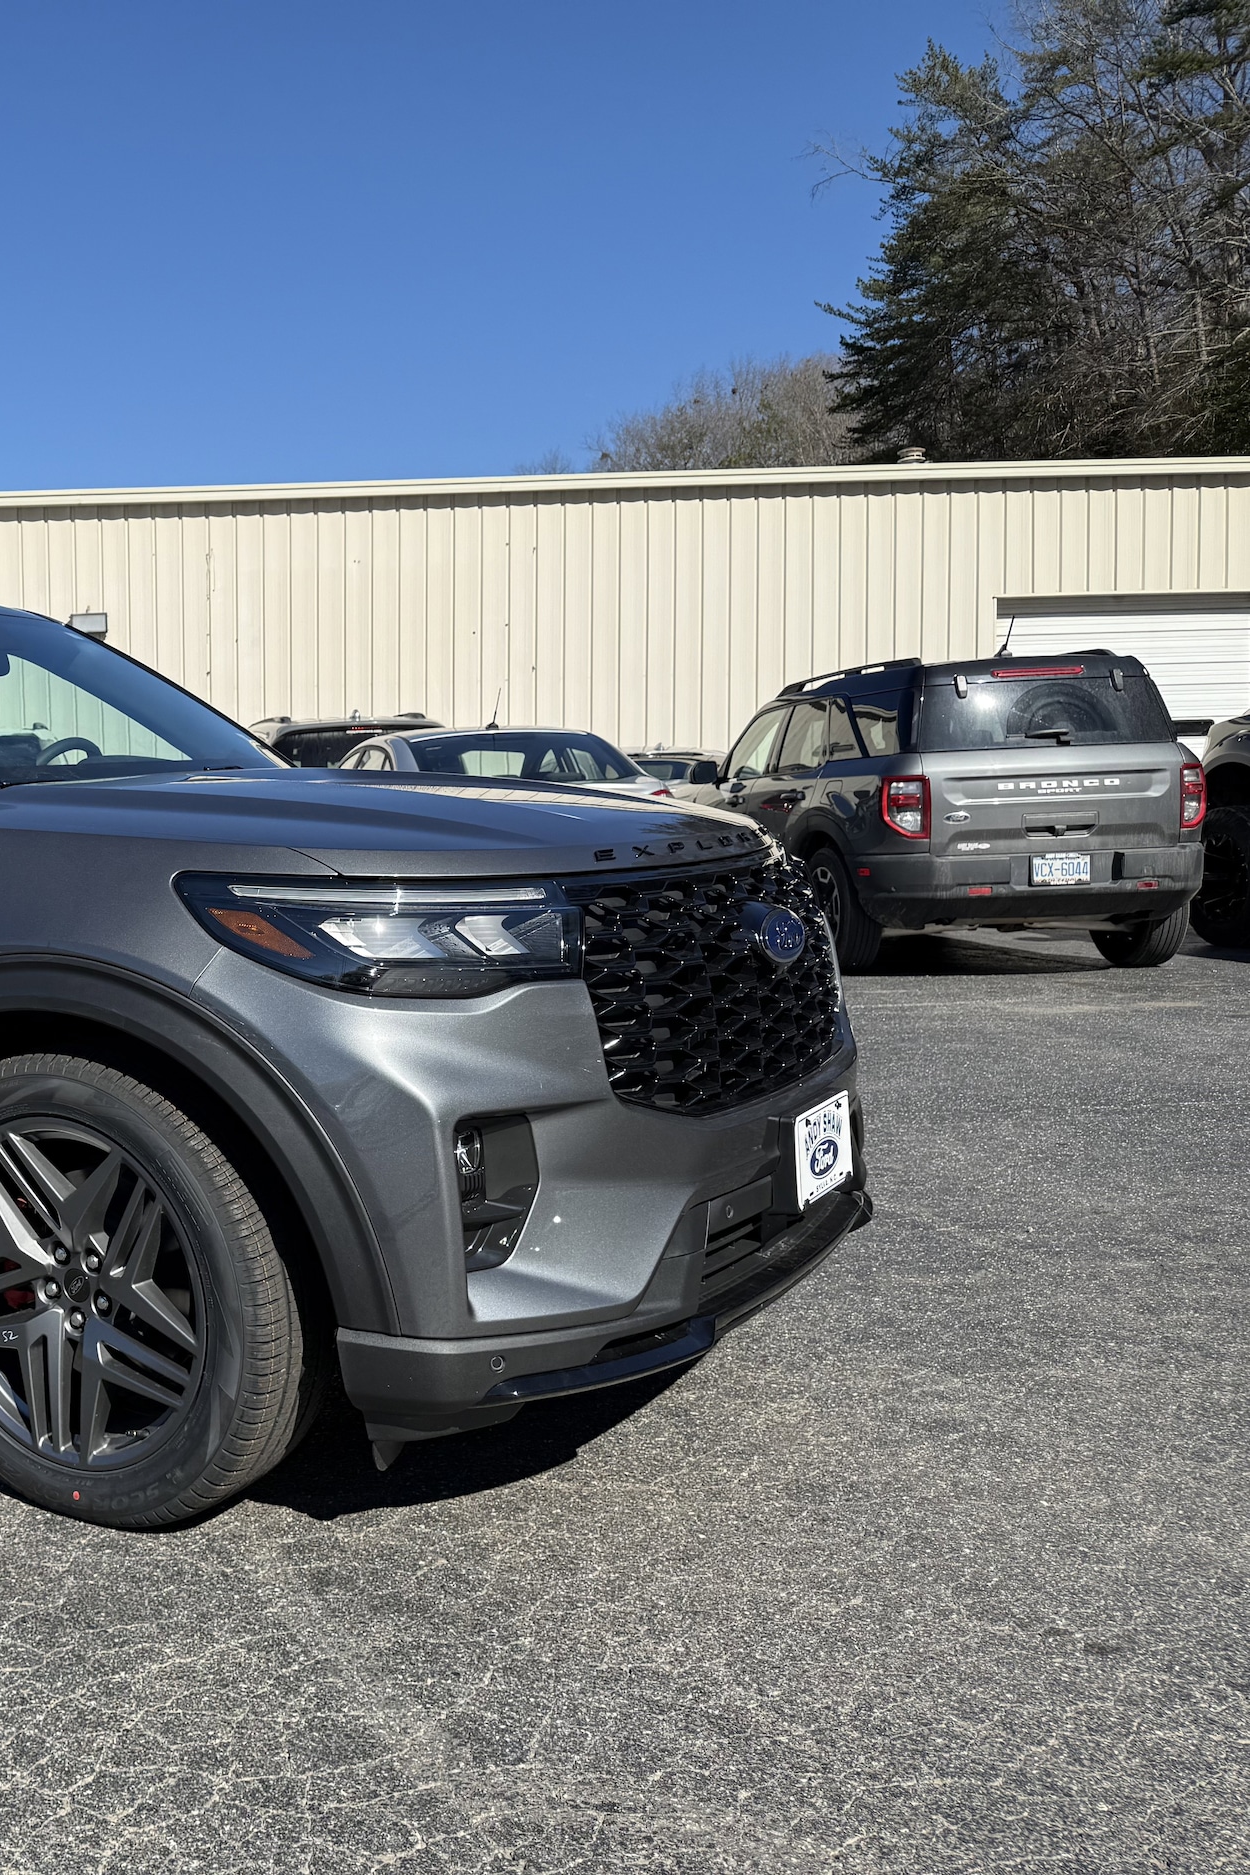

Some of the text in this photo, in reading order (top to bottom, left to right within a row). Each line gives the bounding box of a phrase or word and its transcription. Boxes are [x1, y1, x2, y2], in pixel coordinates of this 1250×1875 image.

[998, 778, 1120, 791] BRONCO
[593, 827, 767, 863] EXPLOR
[1034, 861, 1088, 877] VCX-6044
[805, 1110, 843, 1160] ANDY SHAW
[814, 1142, 834, 1174] Ford
